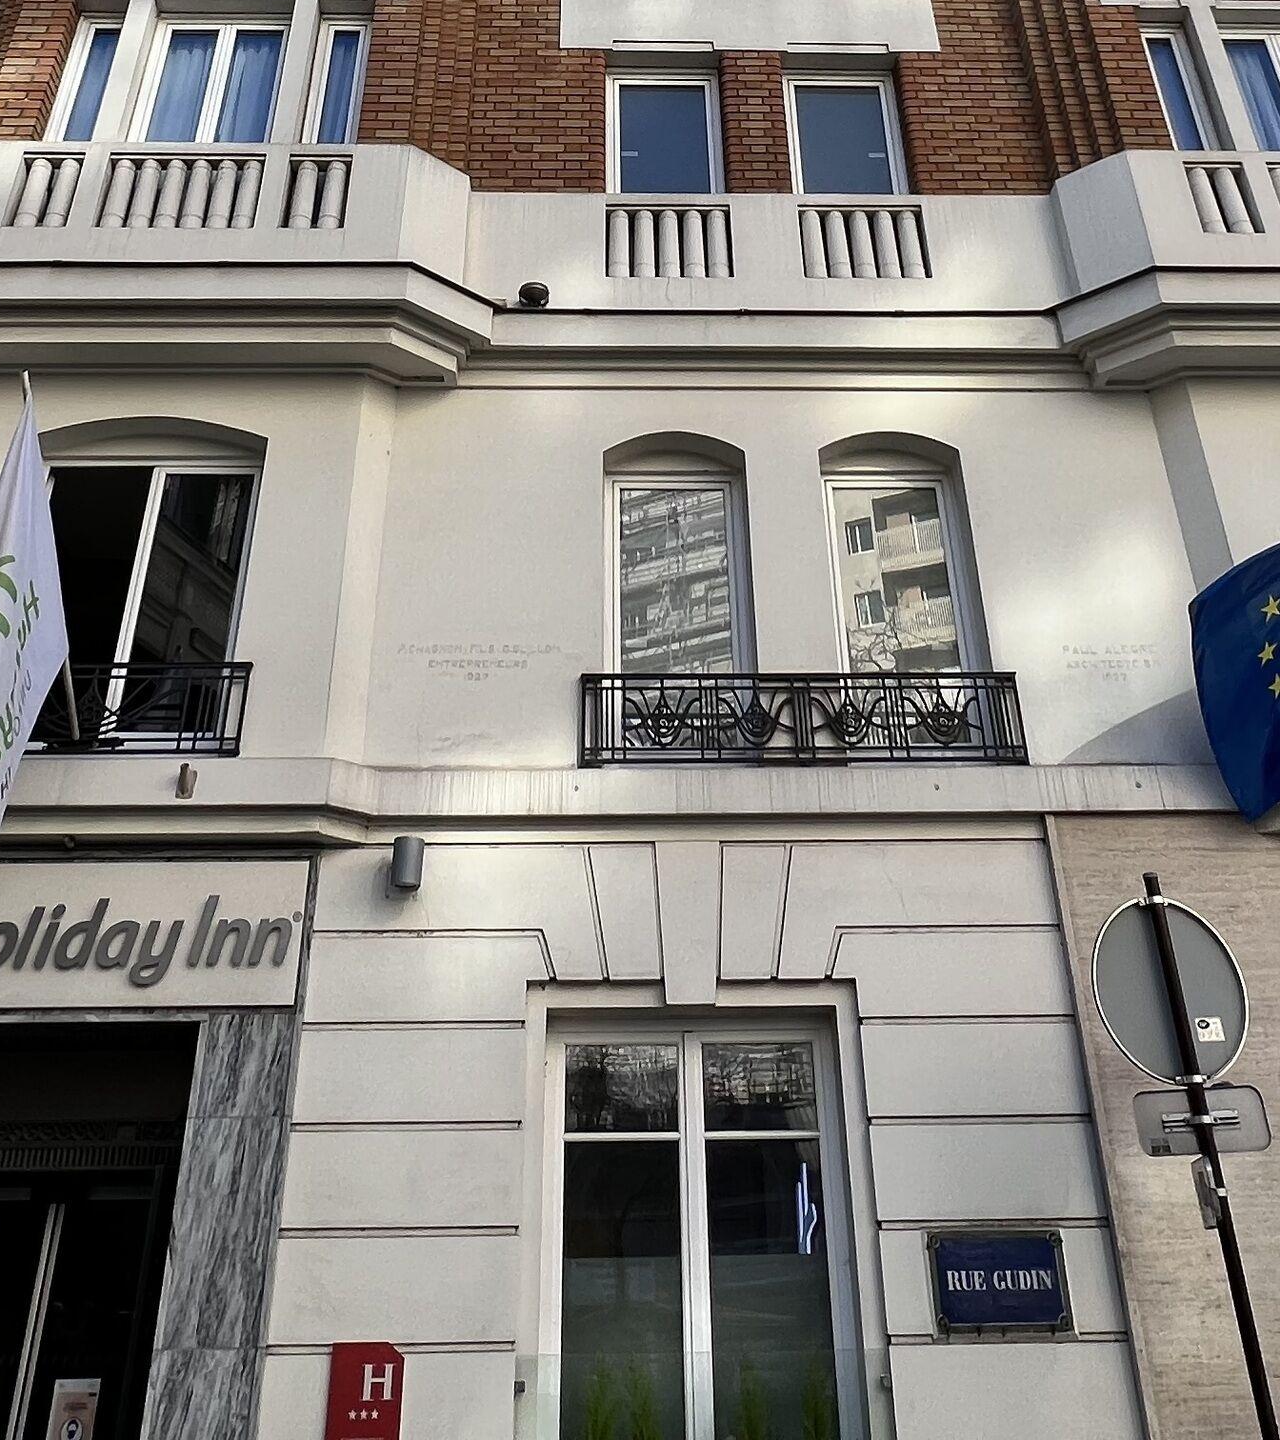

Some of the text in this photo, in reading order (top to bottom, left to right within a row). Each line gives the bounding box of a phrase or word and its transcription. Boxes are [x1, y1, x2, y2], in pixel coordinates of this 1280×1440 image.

[186, 894, 293, 969] Inn
[946, 1269, 1053, 1291] RUE GUDIN
[361, 1363, 396, 1402] H
